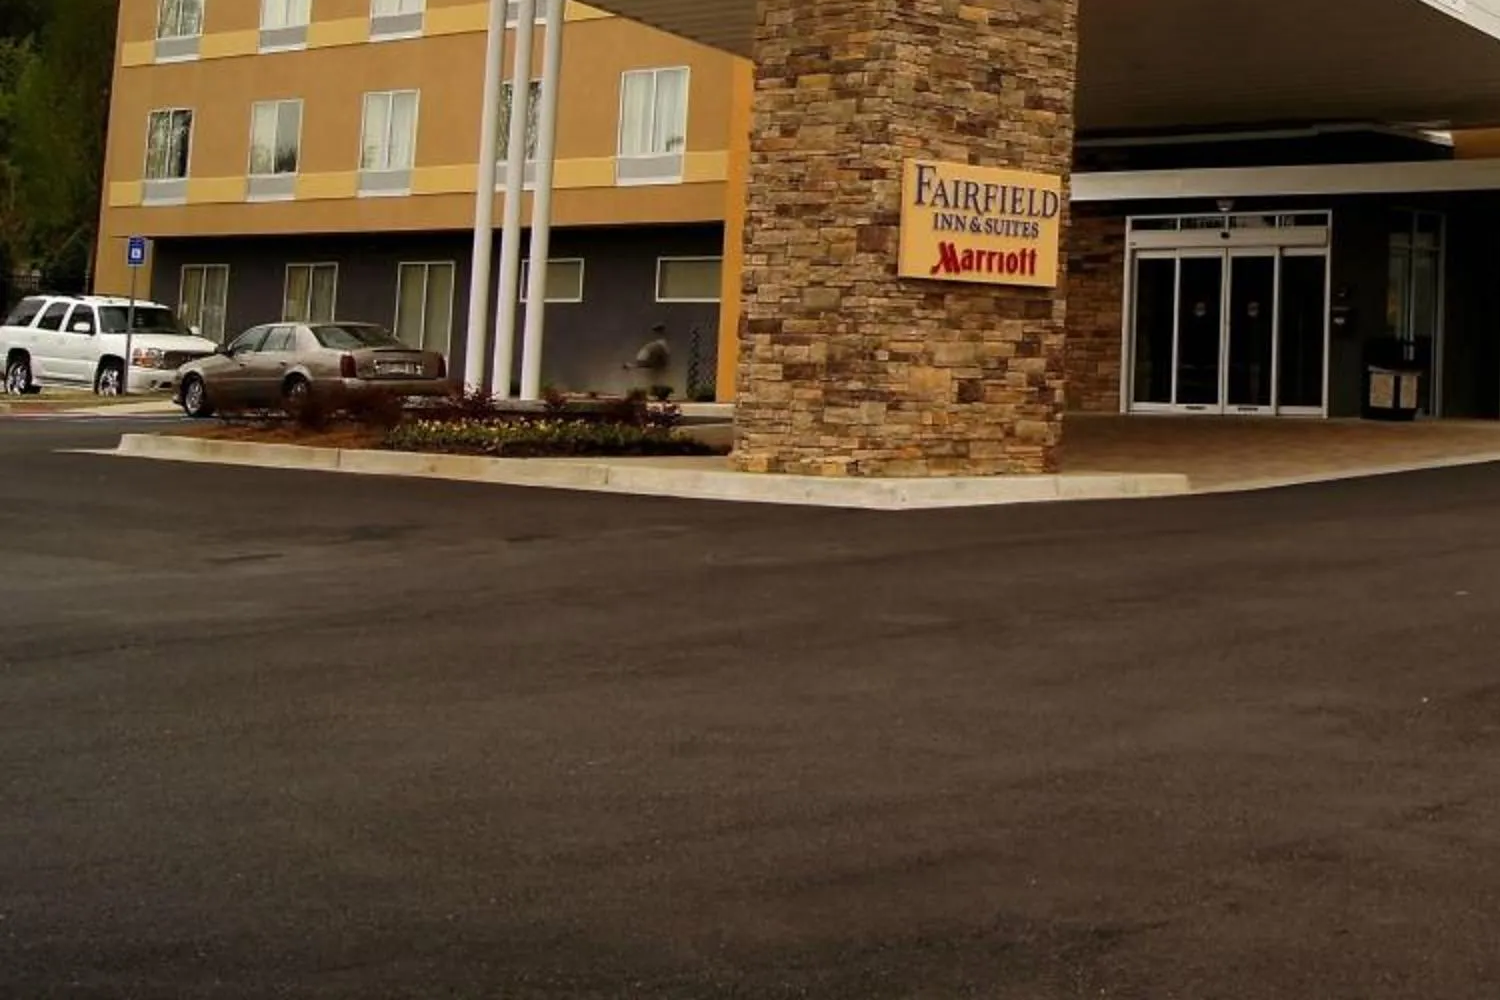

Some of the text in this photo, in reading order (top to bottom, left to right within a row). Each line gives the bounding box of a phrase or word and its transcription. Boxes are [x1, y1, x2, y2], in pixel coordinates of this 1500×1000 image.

[914, 164, 1059, 218] FAIRFIELD
[932, 212, 1040, 239] INN & SUITES
[930, 240, 1037, 276] Marriott
